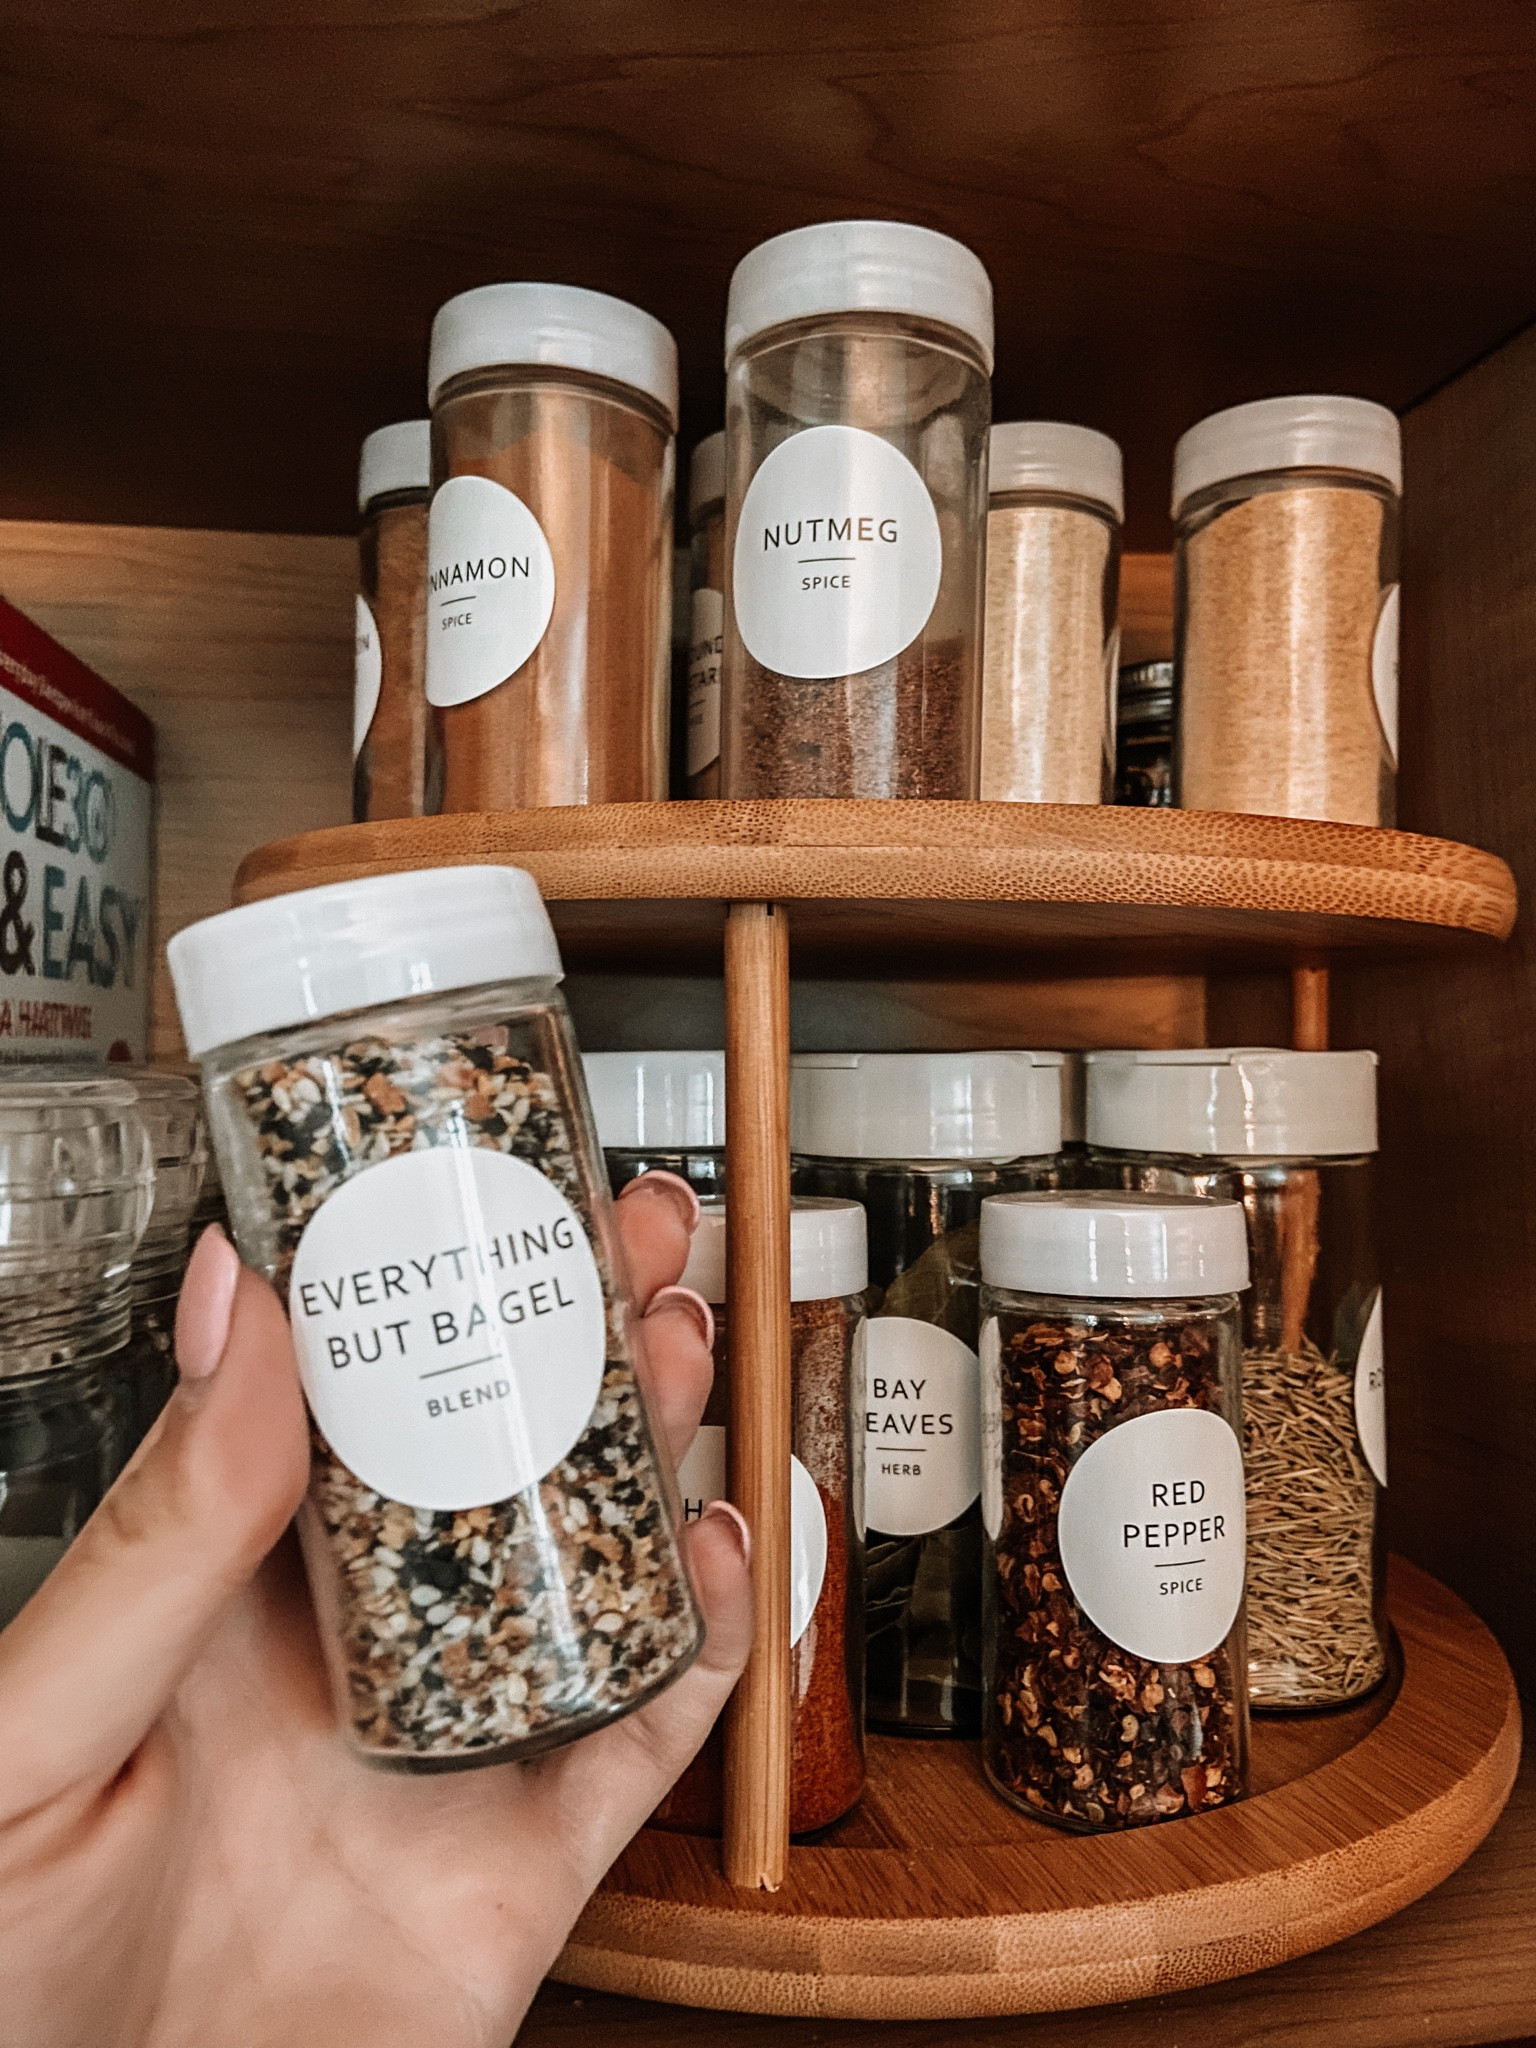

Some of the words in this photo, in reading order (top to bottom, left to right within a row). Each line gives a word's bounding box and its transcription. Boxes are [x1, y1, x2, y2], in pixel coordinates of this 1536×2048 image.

[763, 517, 898, 552] NUTMEG
[801, 575, 851, 590] SPICE
[441, 612, 473, 631] SPICE
[43, 863, 141, 988] EASY
[299, 1216, 575, 1318] EVERYTHING
[327, 1320, 411, 1369] BUT
[431, 1276, 576, 1346] BAGEL
[426, 1378, 512, 1419] BLEND
[873, 1378, 927, 1400] BAY
[881, 1463, 922, 1476] HERB
[1151, 1479, 1206, 1508] RED
[1122, 1514, 1226, 1549] PEPPER
[1158, 1577, 1204, 1597] SPICE
